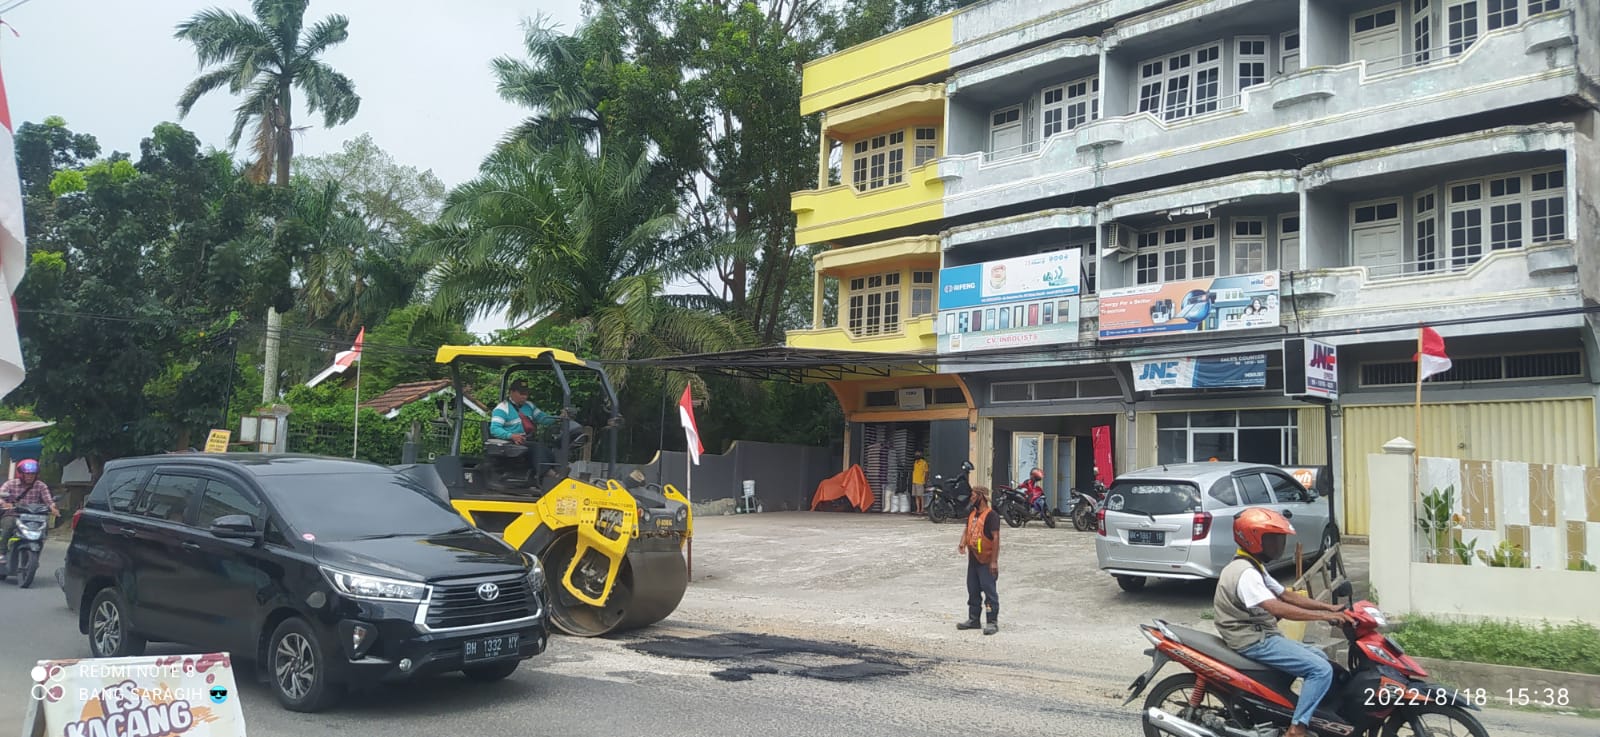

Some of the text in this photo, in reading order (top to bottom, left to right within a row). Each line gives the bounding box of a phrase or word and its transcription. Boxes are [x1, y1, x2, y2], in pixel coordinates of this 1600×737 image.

[954, 282, 976, 290] RIFENG
[1310, 344, 1336, 372] JNE
[1138, 362, 1179, 380] JNE
[466, 642, 476, 655] BH
[484, 638, 502, 652] 1332
[101, 680, 141, 715] ES
